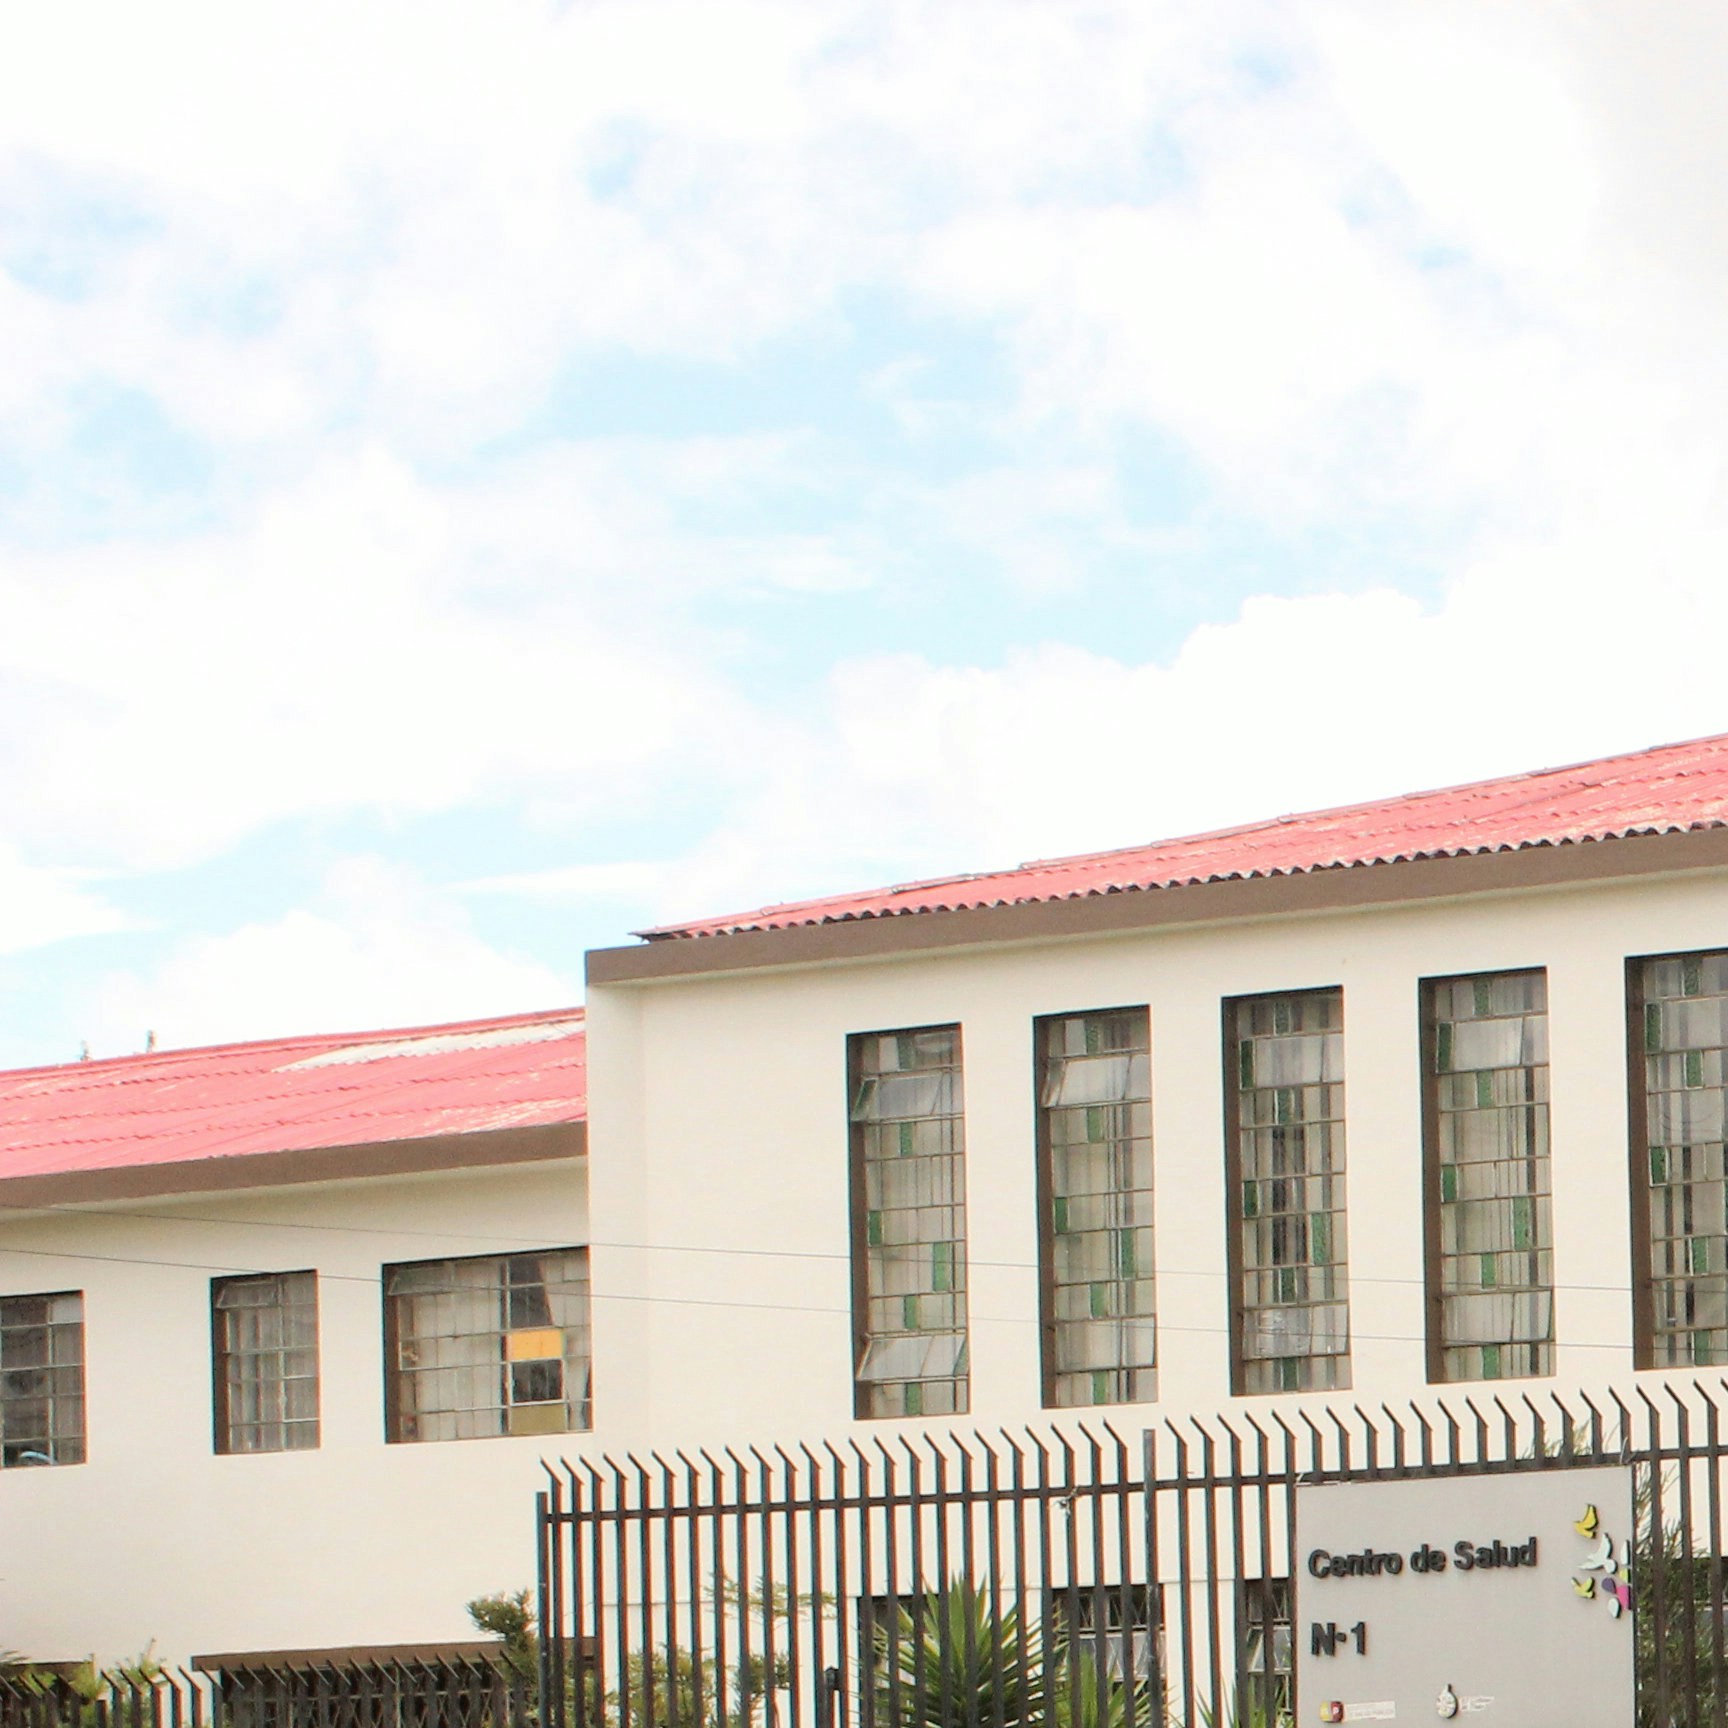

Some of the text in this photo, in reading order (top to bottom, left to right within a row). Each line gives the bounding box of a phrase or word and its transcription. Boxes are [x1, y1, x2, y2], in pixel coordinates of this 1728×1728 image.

[1308, 1536, 1538, 1579] Centro de Salud
